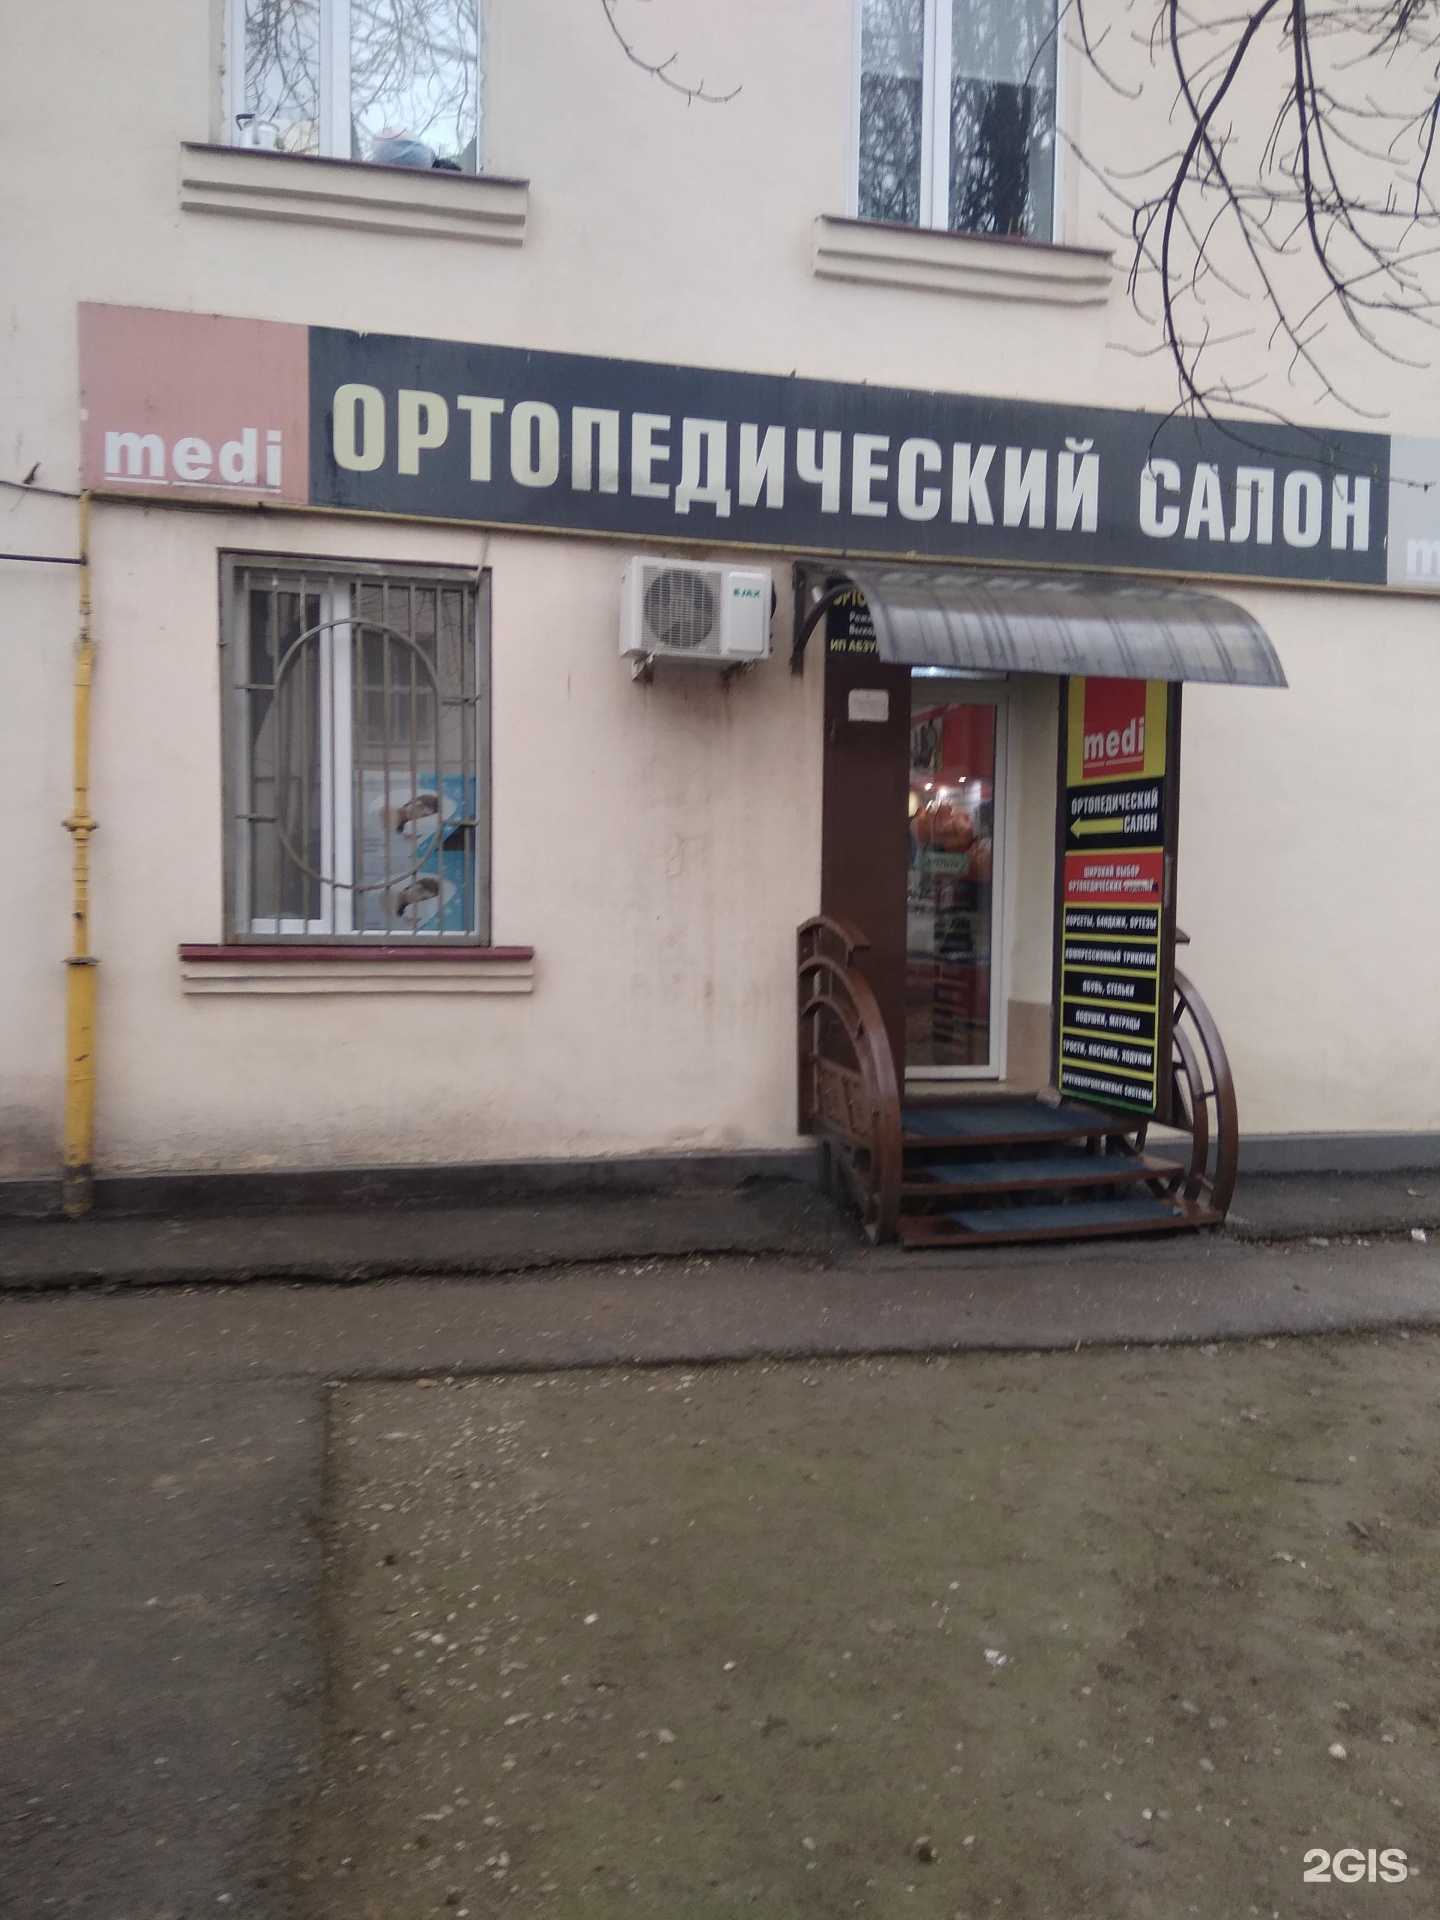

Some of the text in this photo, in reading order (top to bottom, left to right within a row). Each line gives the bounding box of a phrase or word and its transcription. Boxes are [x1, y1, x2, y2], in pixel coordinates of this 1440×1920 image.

[104, 427, 282, 492] medi
[332, 383, 1371, 552] ОРТОПЕДИЧЕСКИЙ САЛОН
[1083, 718, 1144, 765] medi
[1071, 786, 1158, 815] ОРТОПЕДИЧЕСКИЙ
[1123, 812, 1158, 834] САЛОН
[1068, 878, 1121, 893] ОРТОПЕДИЧЕСКИХ
